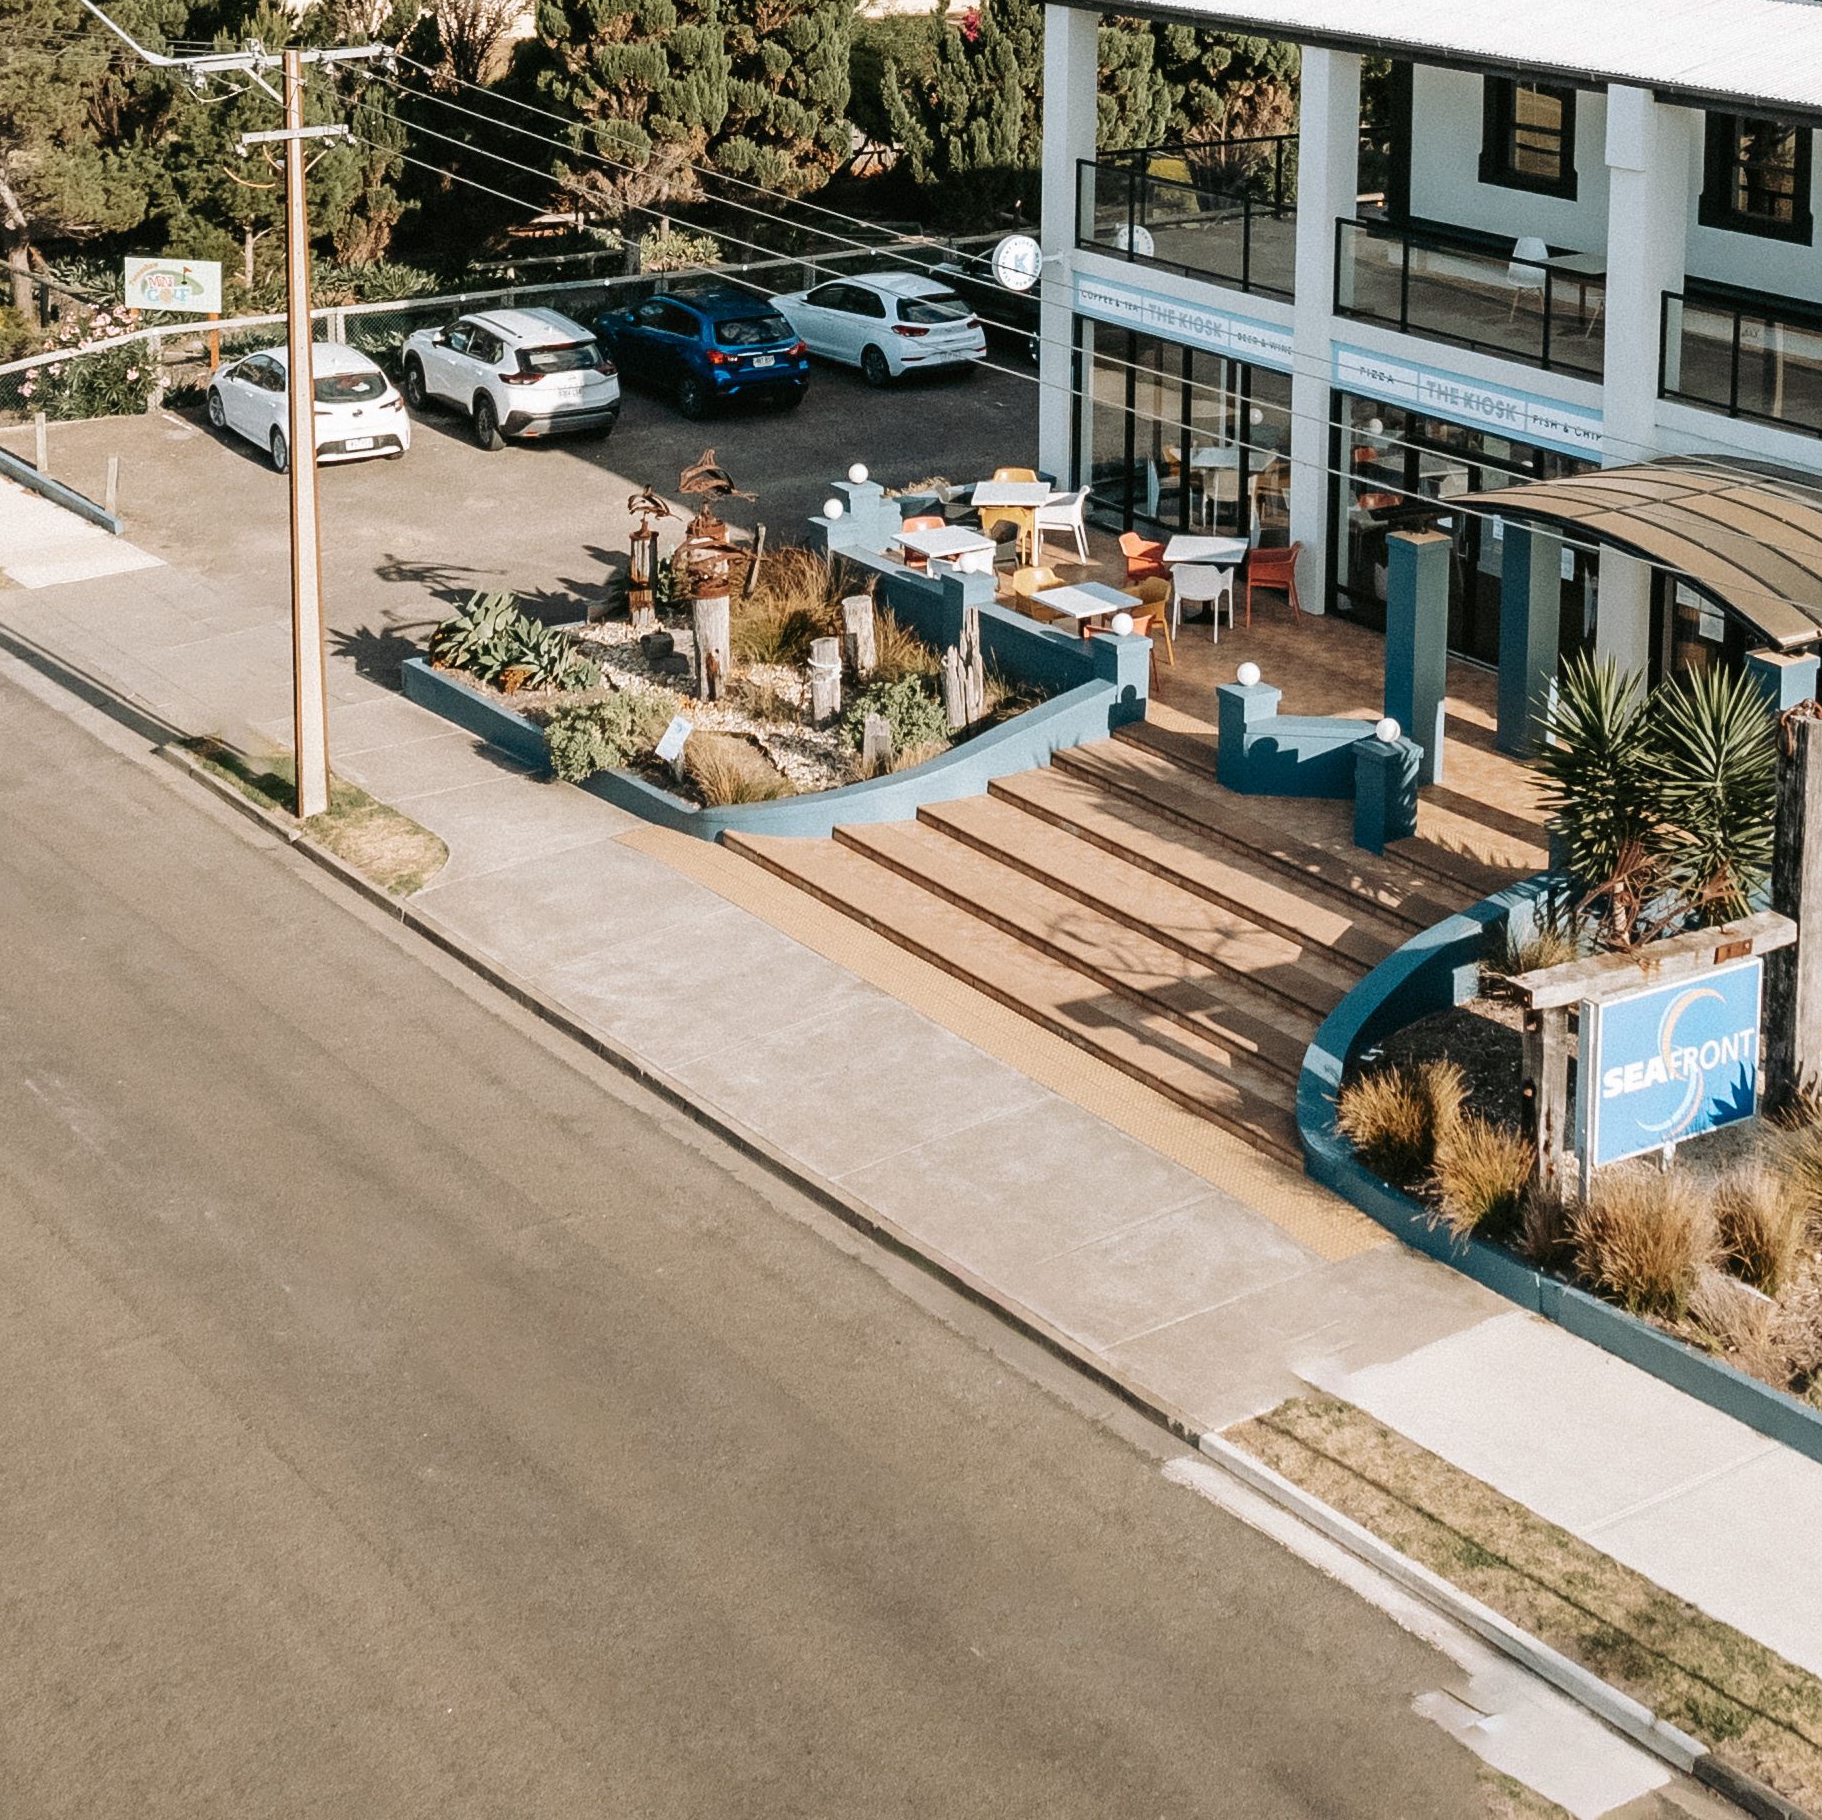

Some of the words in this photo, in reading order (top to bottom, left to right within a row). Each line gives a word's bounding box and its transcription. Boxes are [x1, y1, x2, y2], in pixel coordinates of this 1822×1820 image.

[1081, 290, 1113, 305] COFFEE
[1115, 298, 1120, 307] &
[1147, 303, 1176, 326] THE
[1178, 310, 1223, 338] KIOSK
[1359, 366, 1395, 384] PIZZA
[1427, 380, 1459, 406] THE
[1462, 388, 1517, 422] KIOSK
[1532, 414, 1558, 430] FISH
[1563, 422, 1569, 433] &
[1602, 1027, 1755, 1099] SEAFRONT
